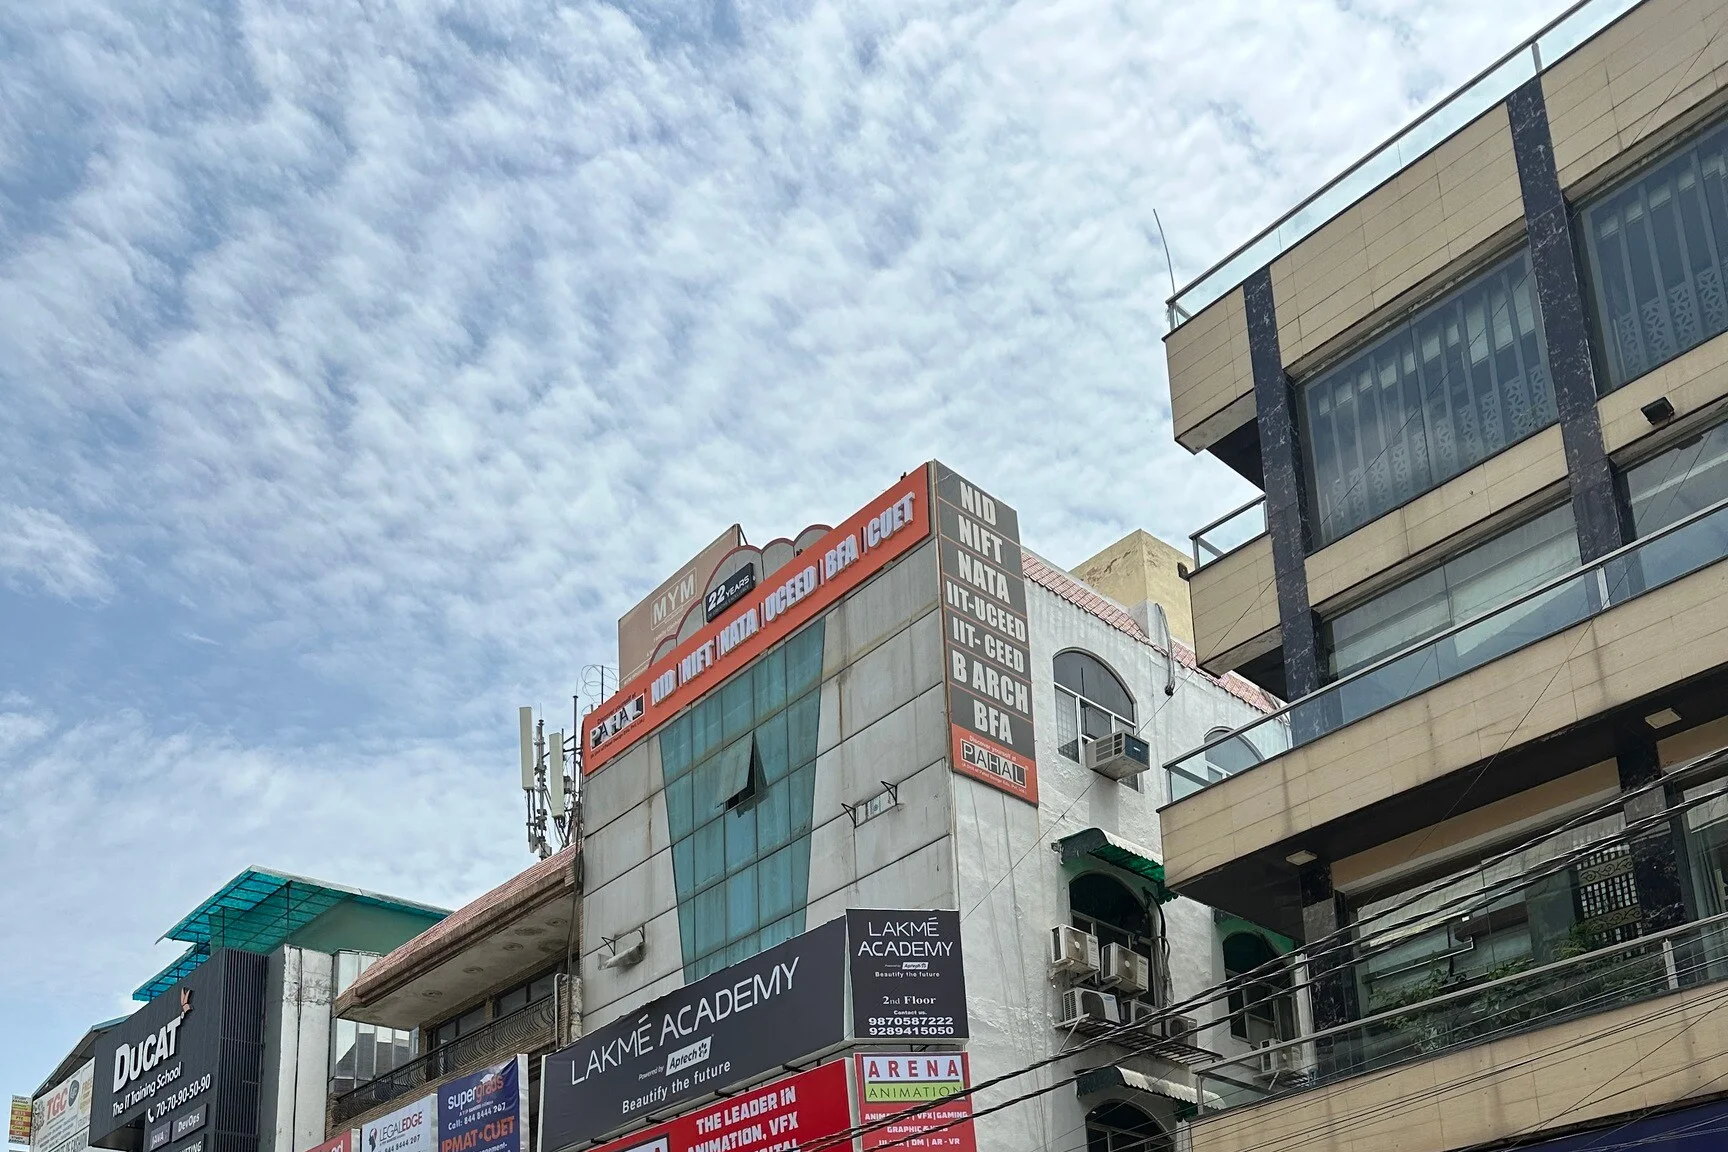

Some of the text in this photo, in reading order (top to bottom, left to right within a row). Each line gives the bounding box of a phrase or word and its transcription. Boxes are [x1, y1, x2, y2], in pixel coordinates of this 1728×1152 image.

[960, 481, 997, 527] NID
[958, 514, 1003, 564] NIFT
[707, 585, 726, 612] 22
[725, 574, 750, 598] YEARS
[958, 551, 1011, 605] NATA
[651, 669, 677, 707] NID
[682, 639, 715, 685] NIFT
[720, 607, 759, 656] NATA
[765, 564, 819, 623] UCEED
[825, 534, 860, 580] BFA
[867, 491, 916, 549] CUET
[652, 574, 695, 626] MYM
[947, 581, 1026, 643] IIT-UCEED
[984, 634, 1025, 674] CEED
[952, 650, 1029, 715] B ARCH
[973, 699, 1013, 745] BFA
[963, 743, 1024, 785] PAHAL
[868, 917, 940, 936] LAKMÉ
[857, 941, 953, 957] ACADEMY
[874, 971, 904, 979] Beautify
[882, 995, 937, 1005] 2nd Floor
[571, 956, 800, 1086] LAKMÉ ACADEMY
[868, 1016, 954, 1026] 9870587222
[869, 1026, 955, 1036] 9289415050
[638, 1050, 698, 1082] Powered Aptech
[868, 1060, 960, 1078] ARENA
[47, 1087, 69, 1118] TGC
[112, 1061, 182, 1117] The Training School
[447, 1073, 504, 1110] supergrads
[622, 1060, 731, 1114] Beautify the future
[178, 1112, 200, 1132] DevOps
[380, 1111, 423, 1142] LEGALEDGE
[448, 1119, 463, 1131] Call:
[463, 1112, 476, 1125] 844
[476, 1107, 492, 1120] 8444
[492, 1101, 506, 1114] 207
[483, 1115, 515, 1142] CUET
[696, 1085, 797, 1136] THE LEADER IN
[769, 1111, 800, 1136] VFX
[936, 1111, 968, 1119] GAMING
